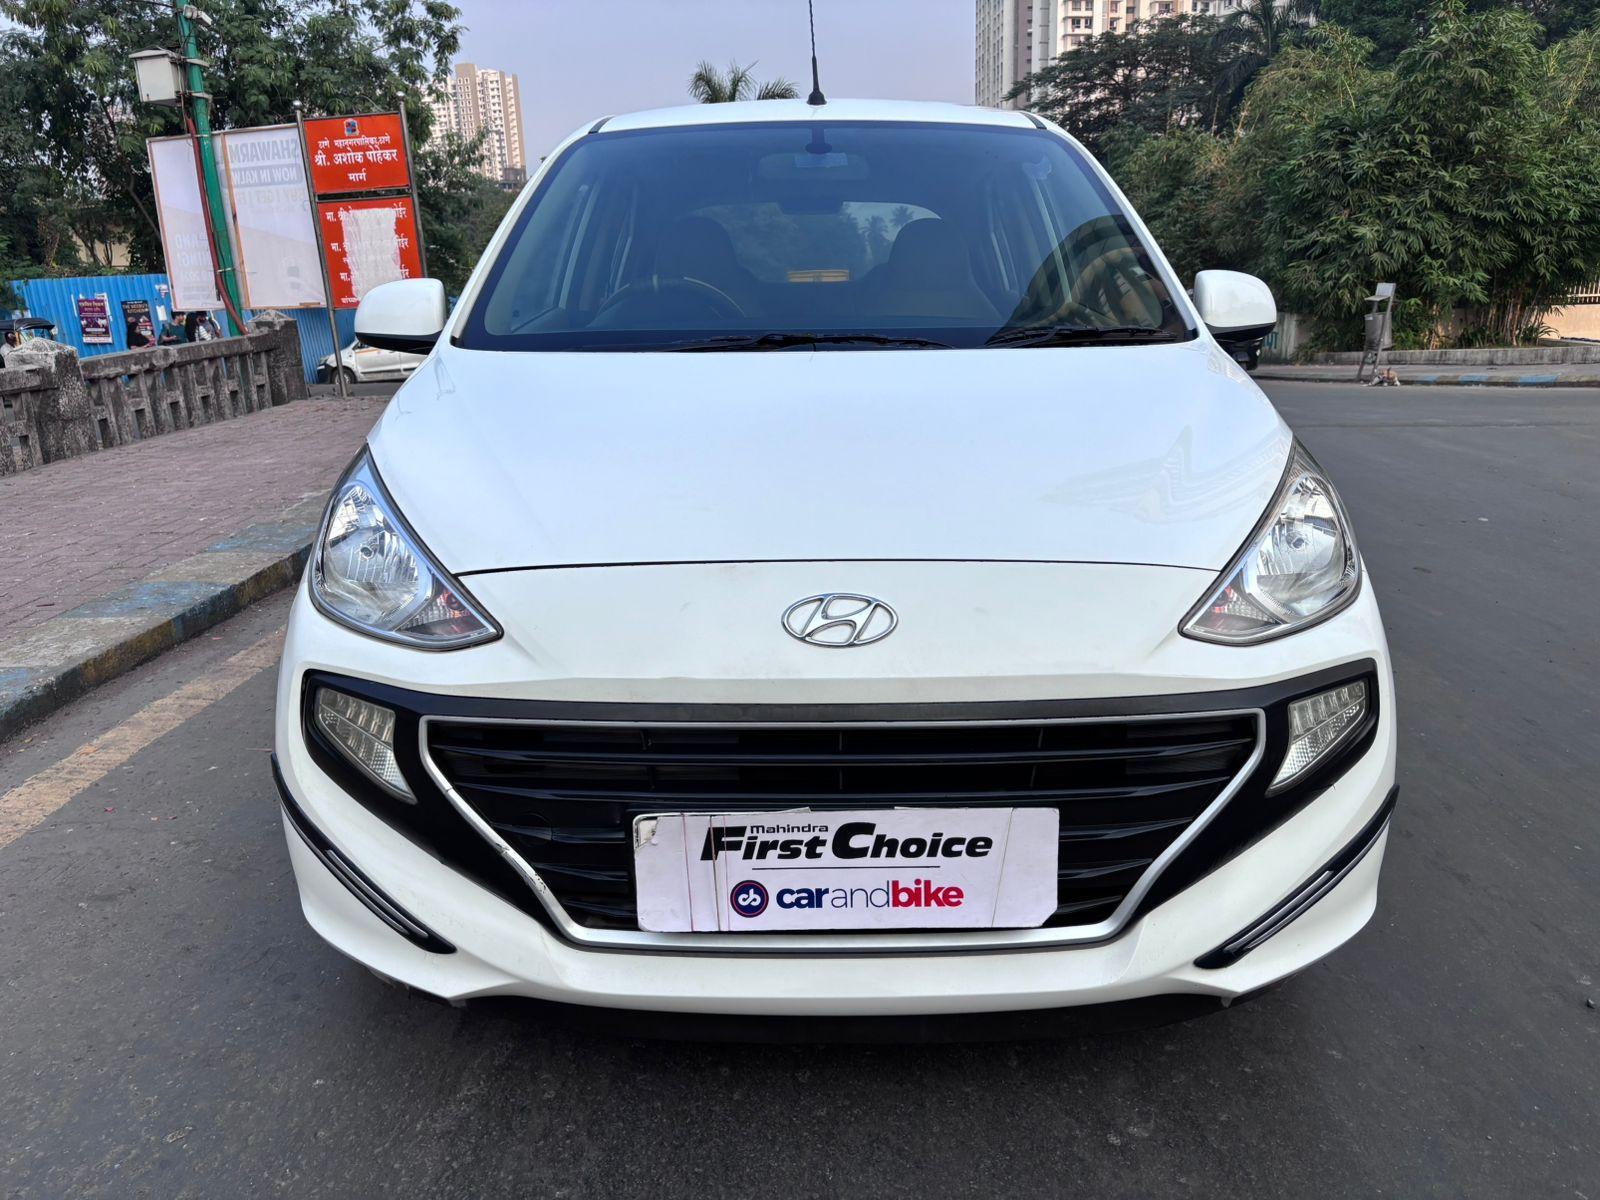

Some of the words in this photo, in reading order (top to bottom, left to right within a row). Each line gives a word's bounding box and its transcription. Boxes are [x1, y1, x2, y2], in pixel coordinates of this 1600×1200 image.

[333, 146, 364, 166] अशोक
[365, 144, 399, 165] पोहेकर
[347, 167, 367, 182] मार्ग
[750, 824, 829, 834] Mahindra
[700, 826, 827, 861] First
[831, 821, 994, 860] Choice
[776, 878, 965, 909] carandbike
